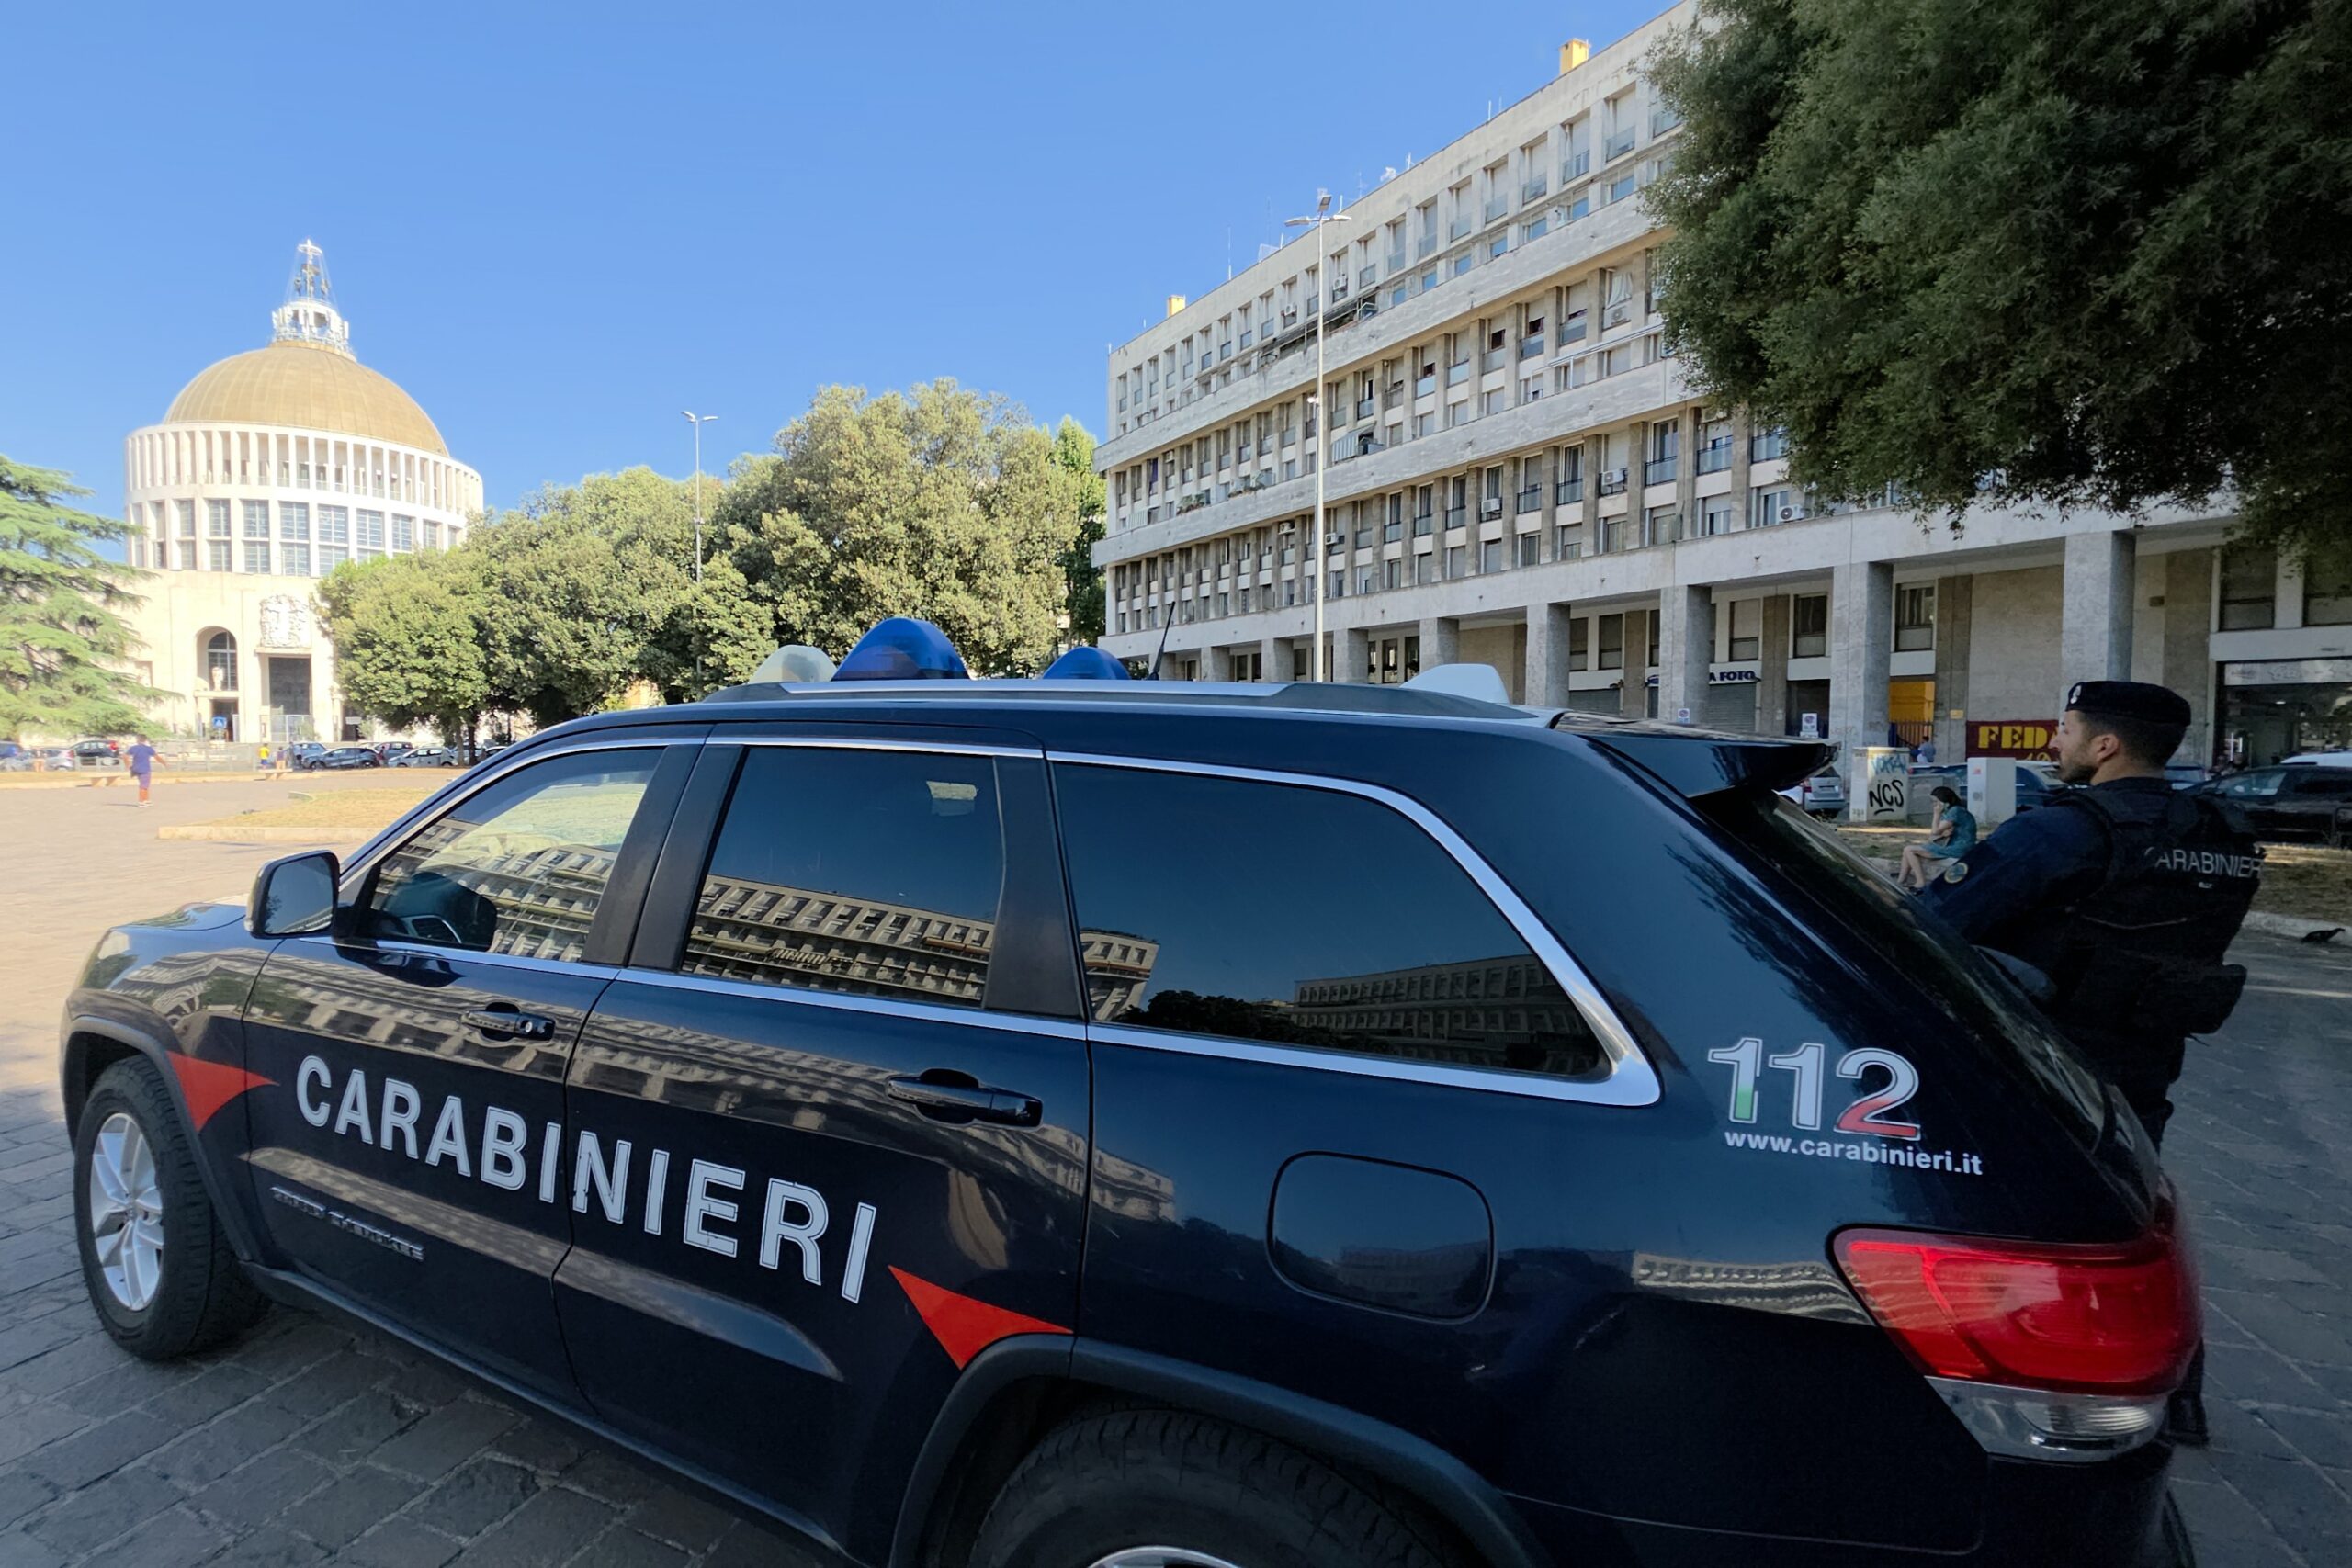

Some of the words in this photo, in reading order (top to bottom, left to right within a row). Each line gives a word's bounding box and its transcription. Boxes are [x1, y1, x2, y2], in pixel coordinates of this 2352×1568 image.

[1719, 671, 1755, 681] FOTO
[1869, 779, 1905, 807] NCS
[2144, 846, 2264, 878] ARABINIER
[1707, 1037, 1921, 1141] 112
[1724, 1131, 1983, 1176] www.carabinieri.it
[296, 1055, 877, 1304] CARABINIERI
